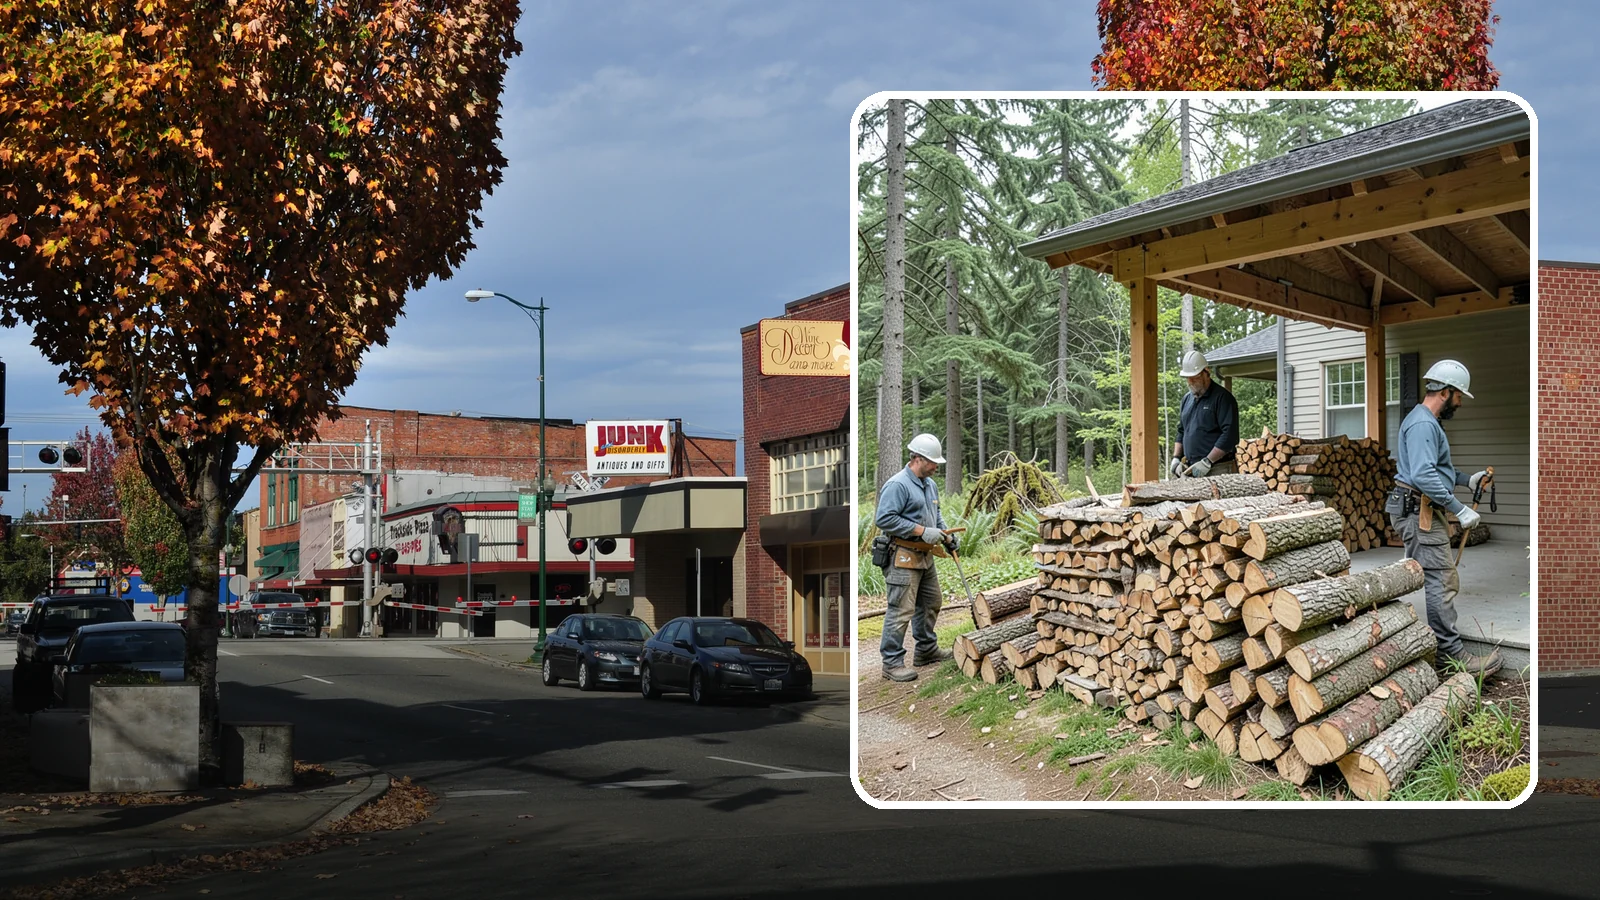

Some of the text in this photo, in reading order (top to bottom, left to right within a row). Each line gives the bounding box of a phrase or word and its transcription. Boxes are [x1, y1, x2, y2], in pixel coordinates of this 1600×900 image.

[595, 425, 665, 457] JUNK
[607, 446, 646, 454] DISORDERLY
[597, 460, 665, 470] ANTIQUES AND GIFTS
[415, 519, 429, 535] Pizza
